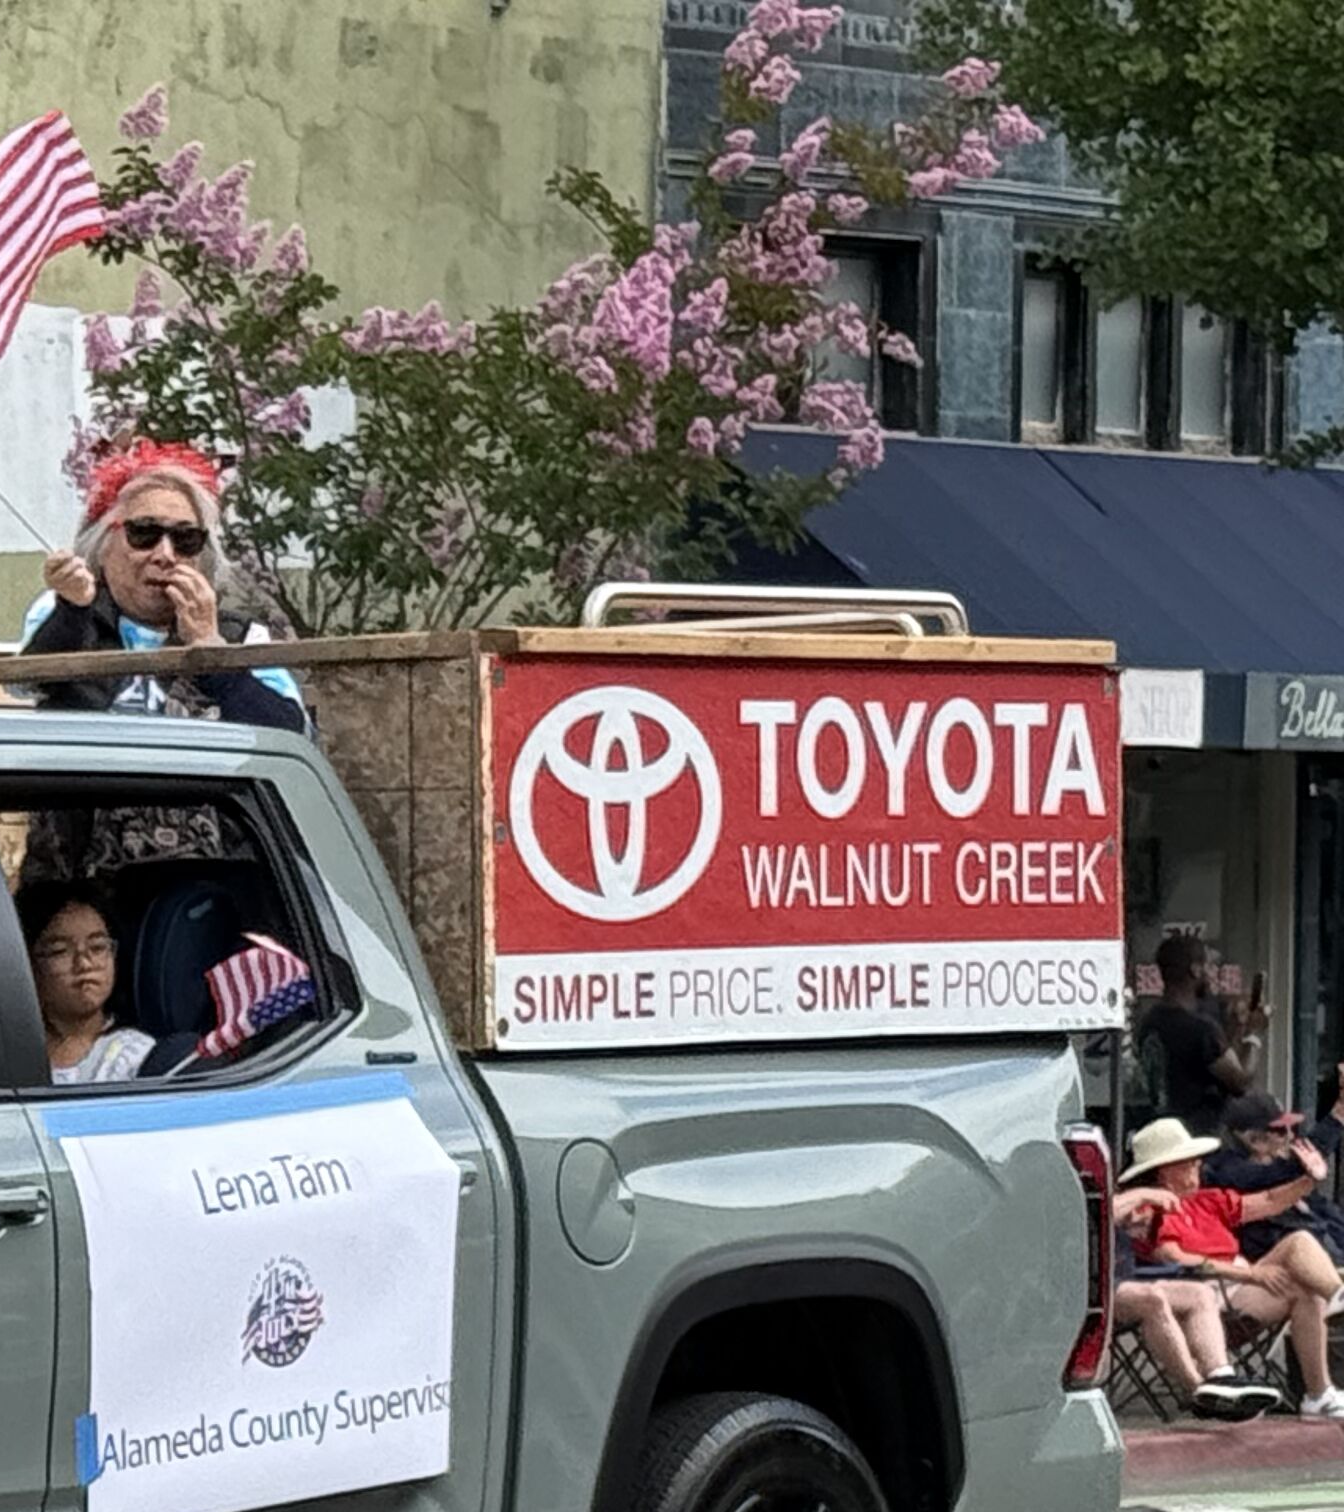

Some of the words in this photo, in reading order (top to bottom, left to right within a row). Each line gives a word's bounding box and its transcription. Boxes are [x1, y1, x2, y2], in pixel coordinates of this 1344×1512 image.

[739, 695, 1107, 819] TOYOTA
[741, 843, 940, 909] WALNUT
[955, 840, 1107, 905] CREEK
[514, 973, 656, 1023] SIMPLE
[669, 966, 784, 1017] PRICE.
[796, 963, 930, 1012] SIMPLE
[192, 1166, 279, 1215] Lena
[271, 1154, 352, 1200] Tam
[97, 1413, 224, 1472] Alameda
[230, 1400, 329, 1447] County
